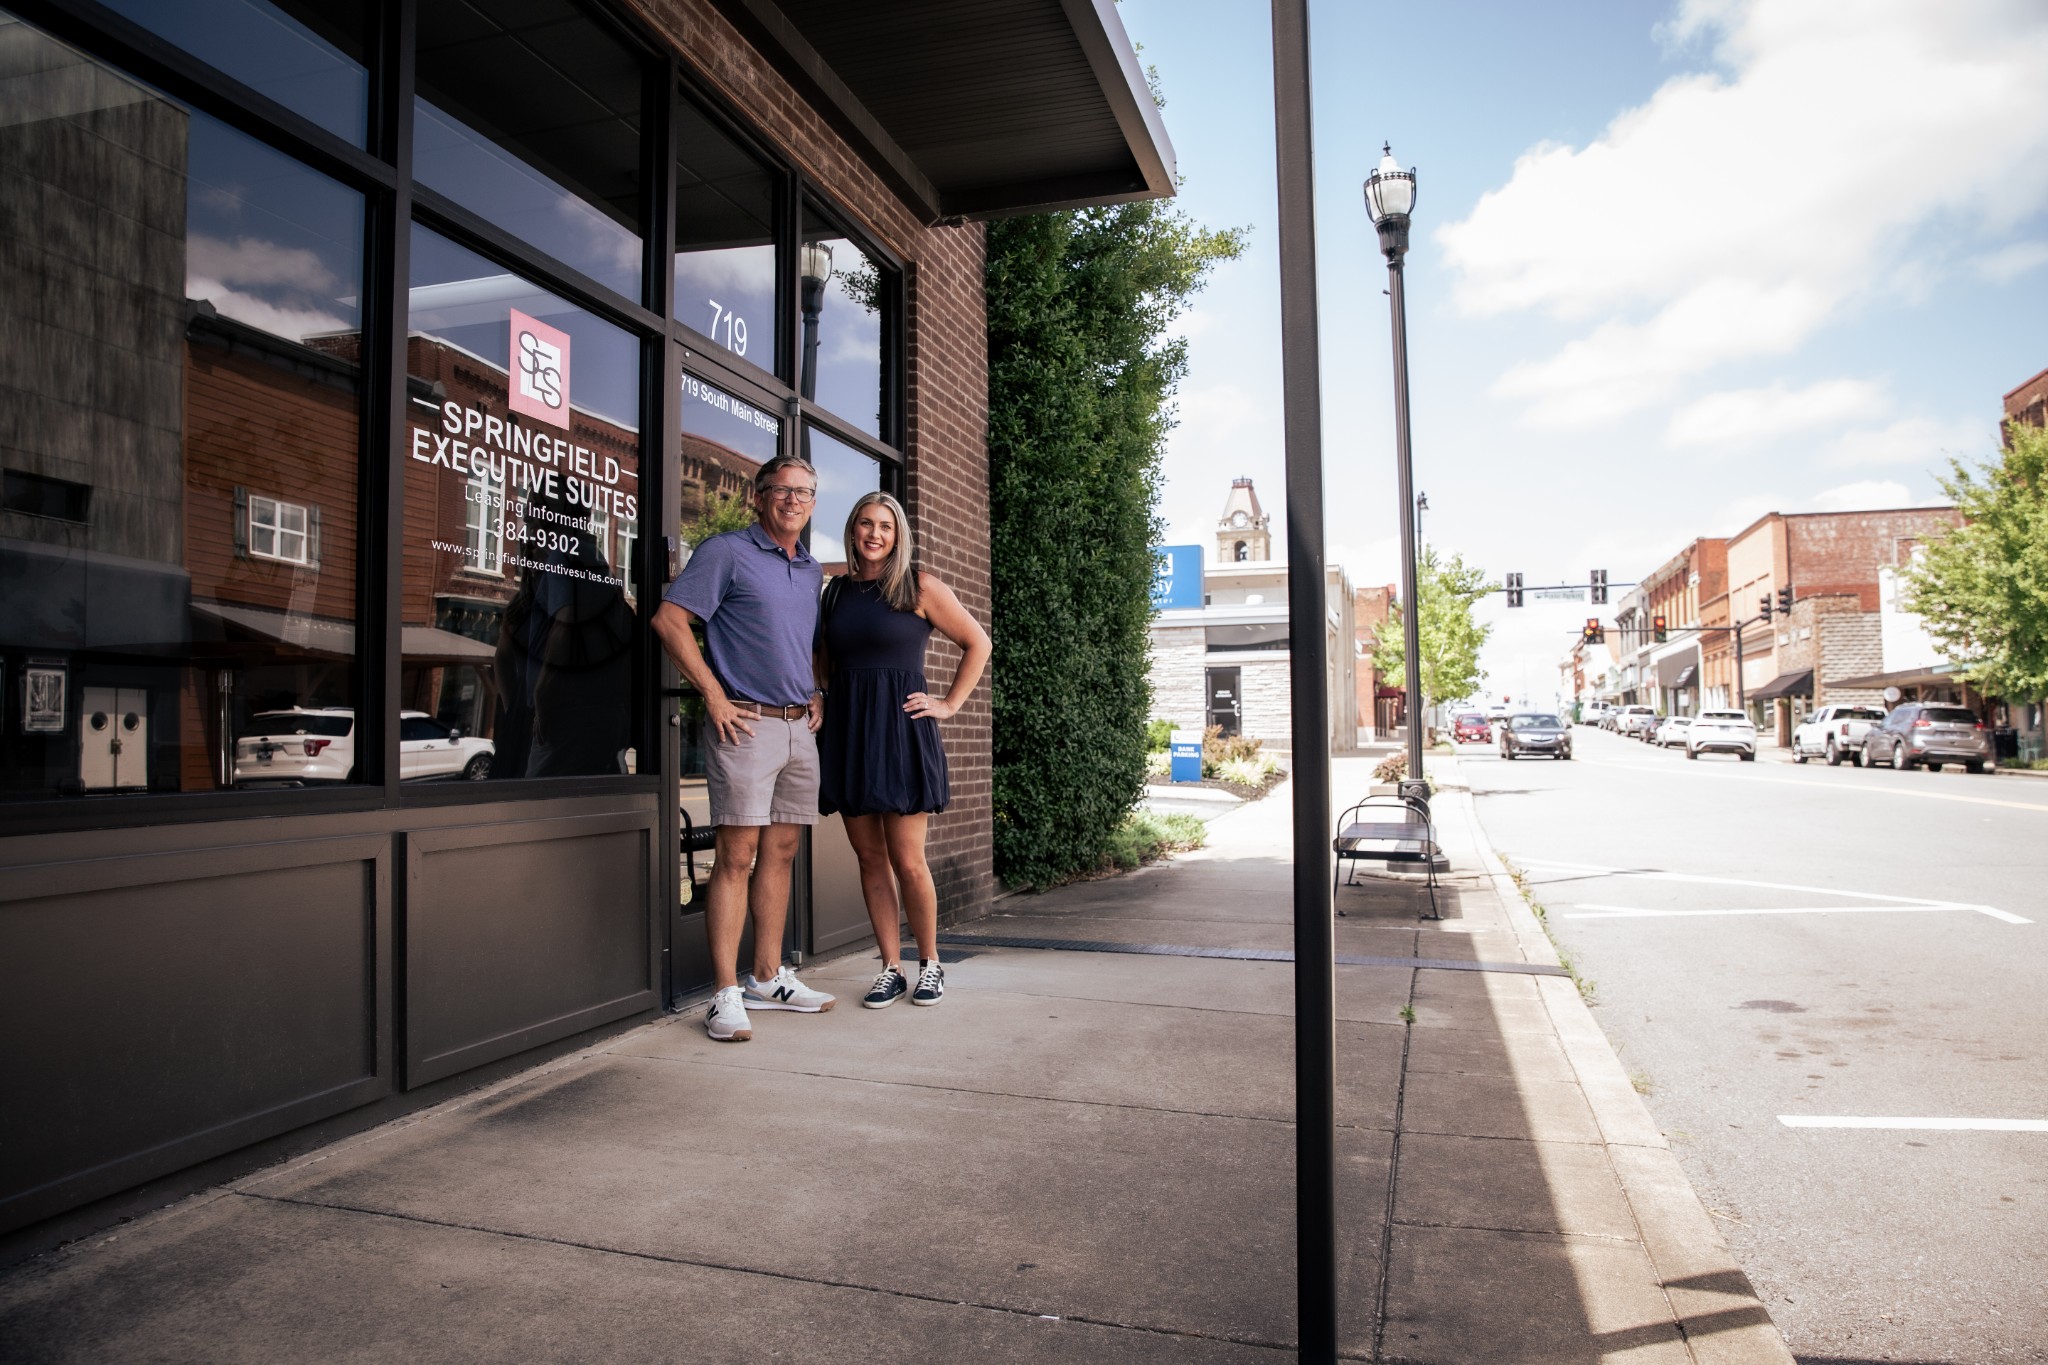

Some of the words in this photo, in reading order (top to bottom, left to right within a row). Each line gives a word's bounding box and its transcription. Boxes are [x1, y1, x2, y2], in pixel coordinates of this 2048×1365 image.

[709, 299, 747, 357] 719
[681, 375, 698, 397] 719
[700, 384, 729, 412] South
[731, 399, 752, 423] Main
[754, 411, 779, 436] Street
[443, 401, 619, 485] SPRINGFIELD
[412, 427, 559, 500] EXECUTIVE
[565, 476, 637, 521] SUITES
[465, 484, 523, 518] Leasing
[528, 503, 602, 535] Information
[493, 518, 579, 556] 384-9302
[431, 539, 623, 587] www.spingfieldexecutivesutes.com
[707, 1004, 719, 1021] N
[772, 985, 795, 1002] N
